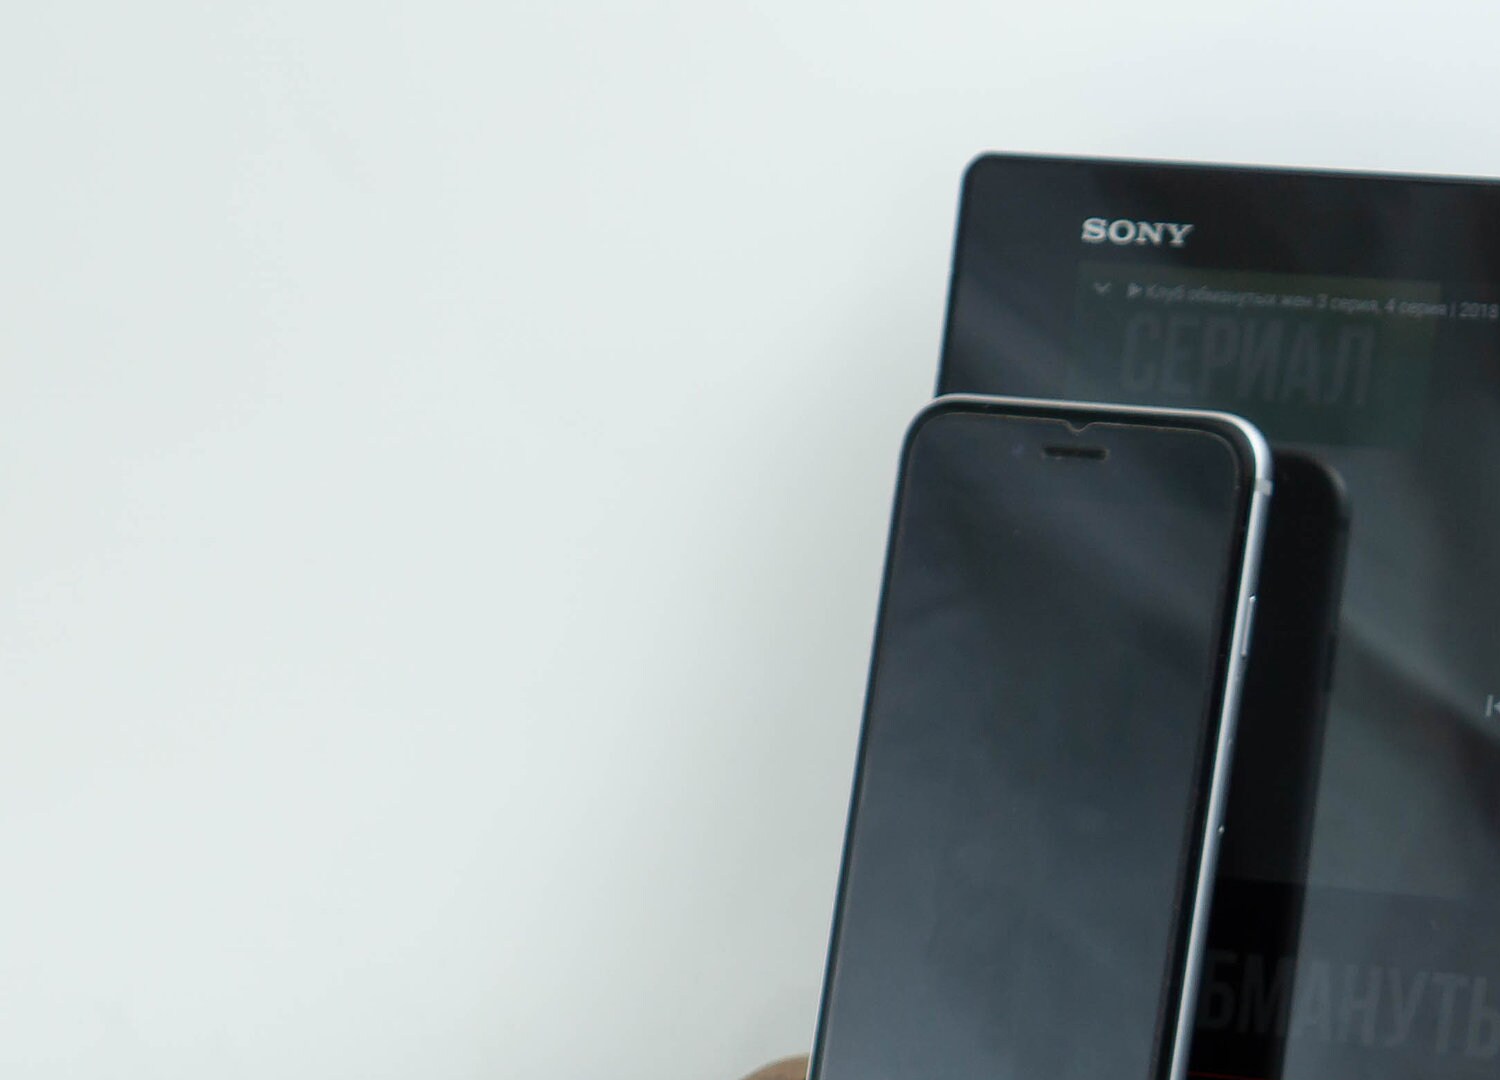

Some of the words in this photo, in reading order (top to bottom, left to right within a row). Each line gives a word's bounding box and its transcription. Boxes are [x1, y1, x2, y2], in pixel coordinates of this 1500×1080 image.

[1081, 217, 1195, 247] SONY
[1459, 301, 1499, 319] 2018
[1120, 311, 1376, 406] СЕРИАЛ
